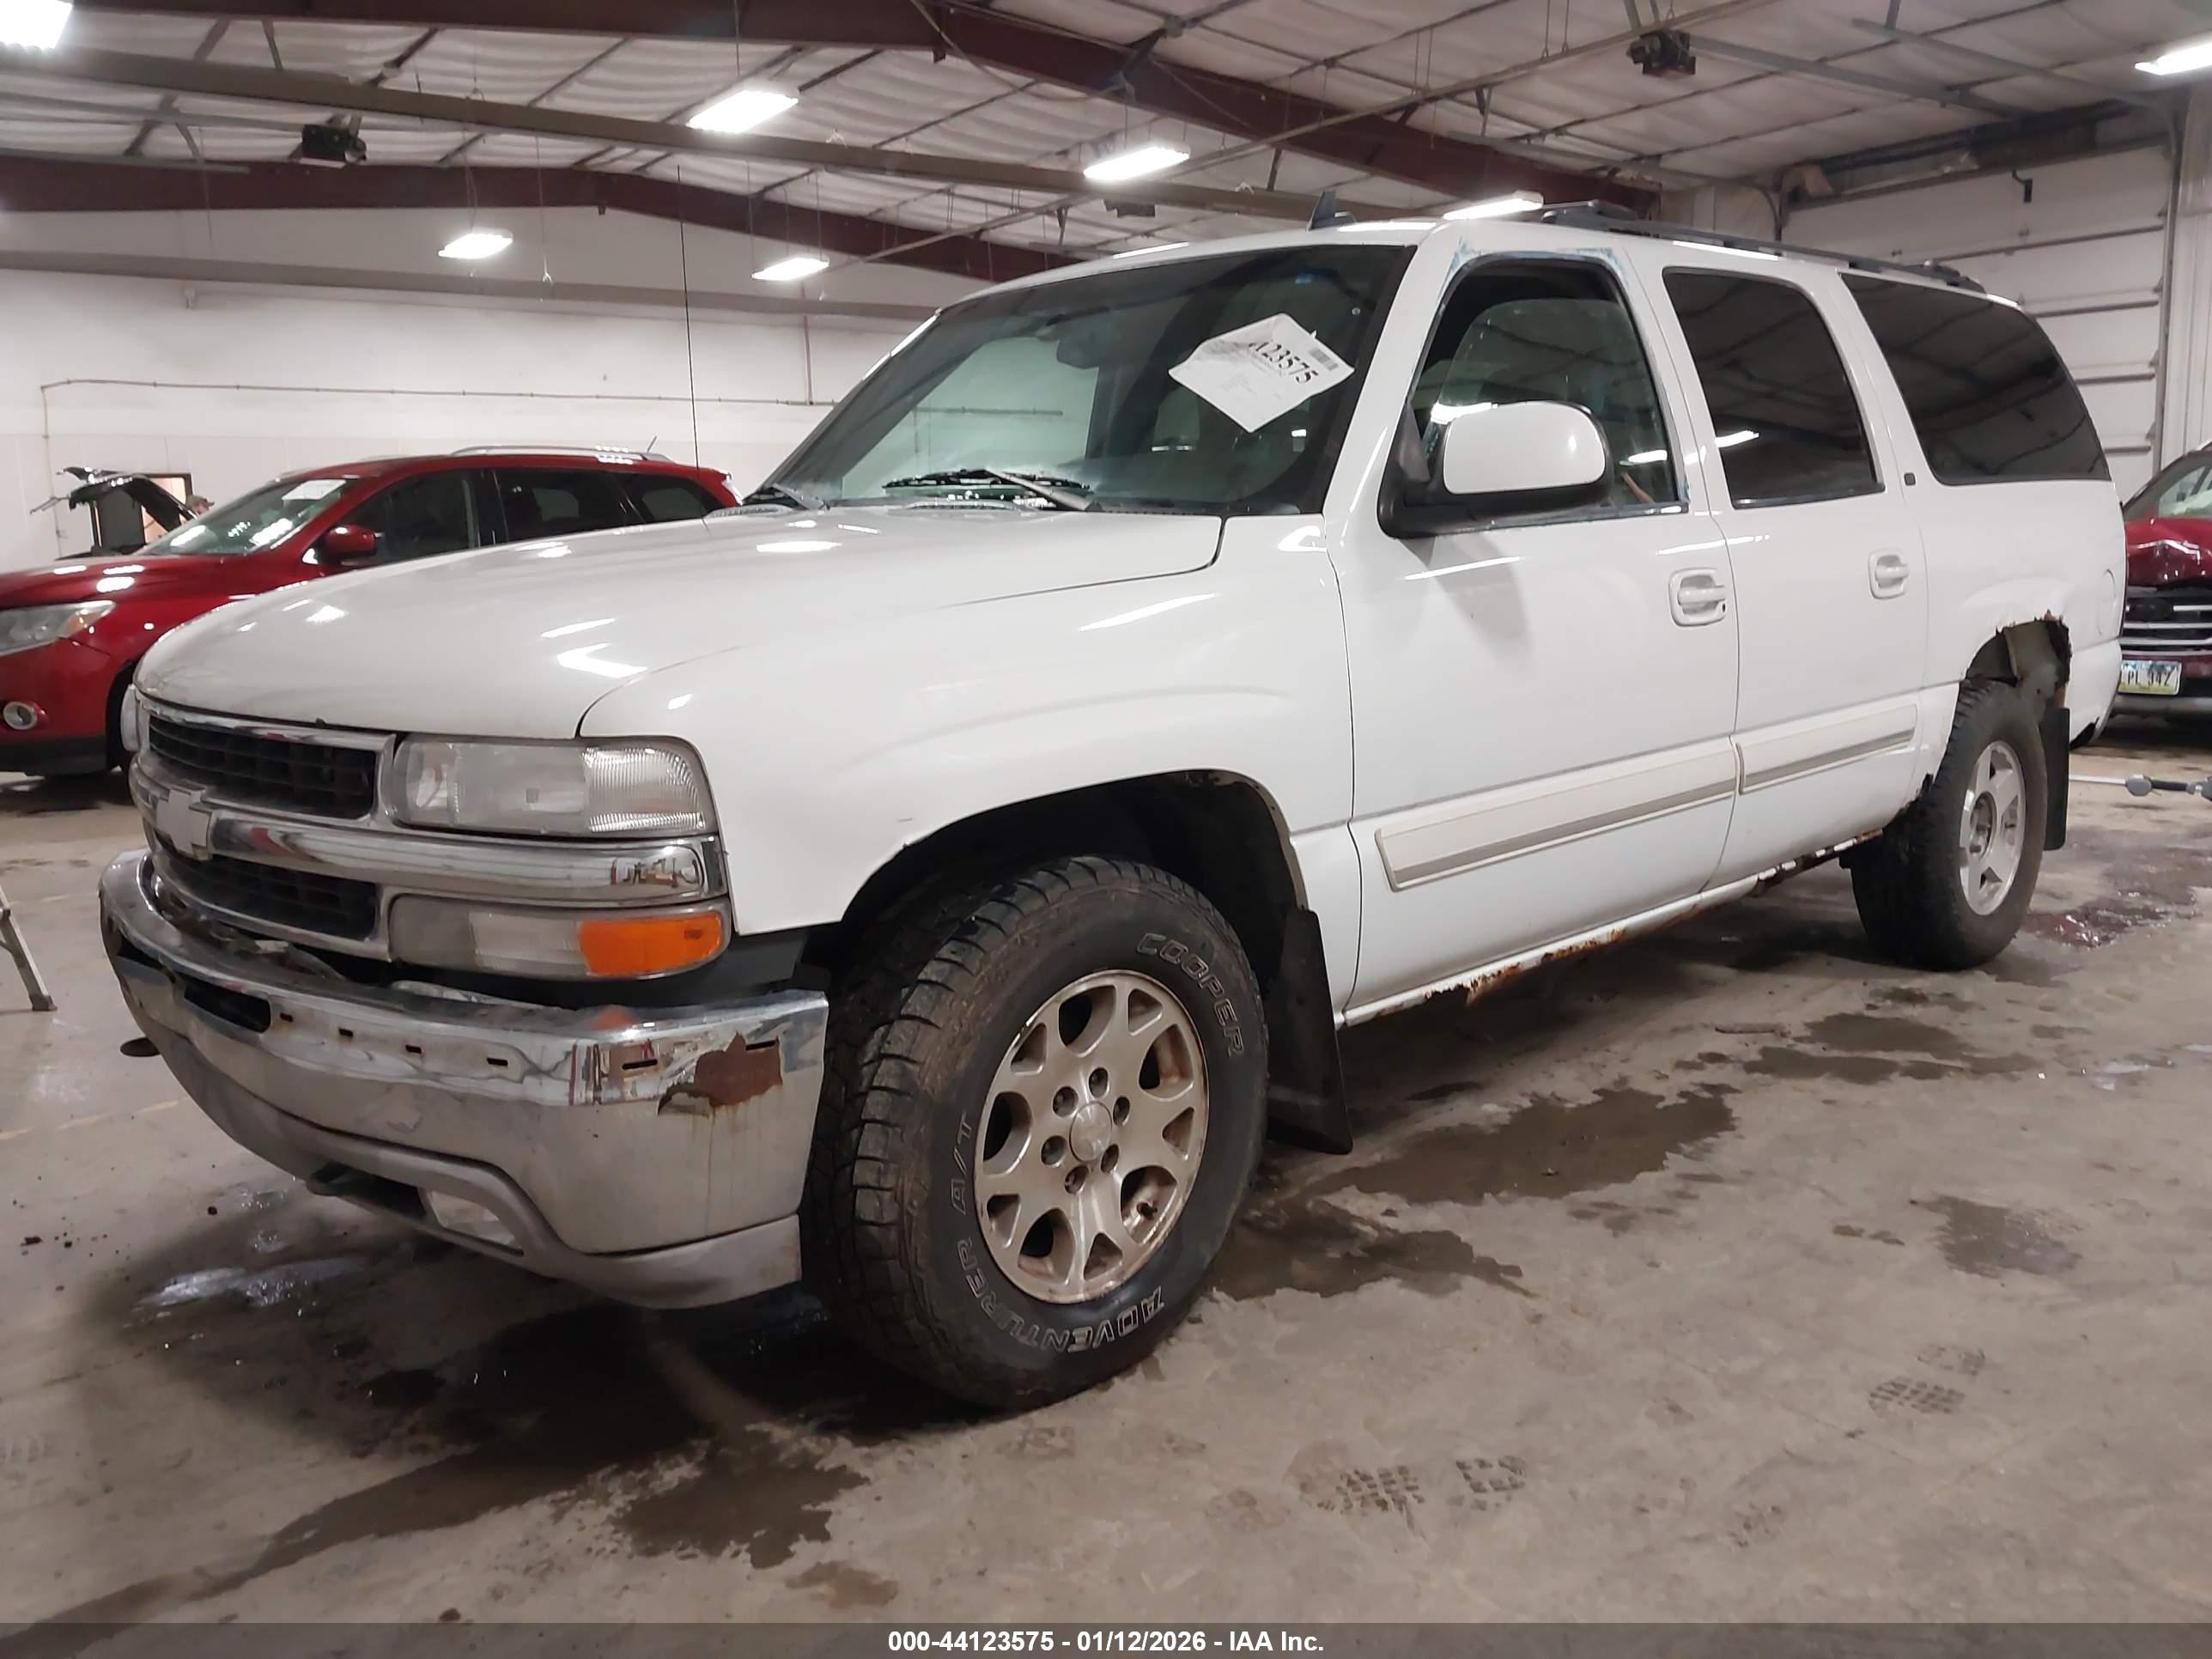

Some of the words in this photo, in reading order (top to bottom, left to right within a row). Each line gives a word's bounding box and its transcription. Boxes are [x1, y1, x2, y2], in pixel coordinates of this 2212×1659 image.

[1137, 933, 1244, 1057] COOPER
[950, 1111, 973, 1216] A/T
[957, 1238, 1165, 1353] ADVENTURER
